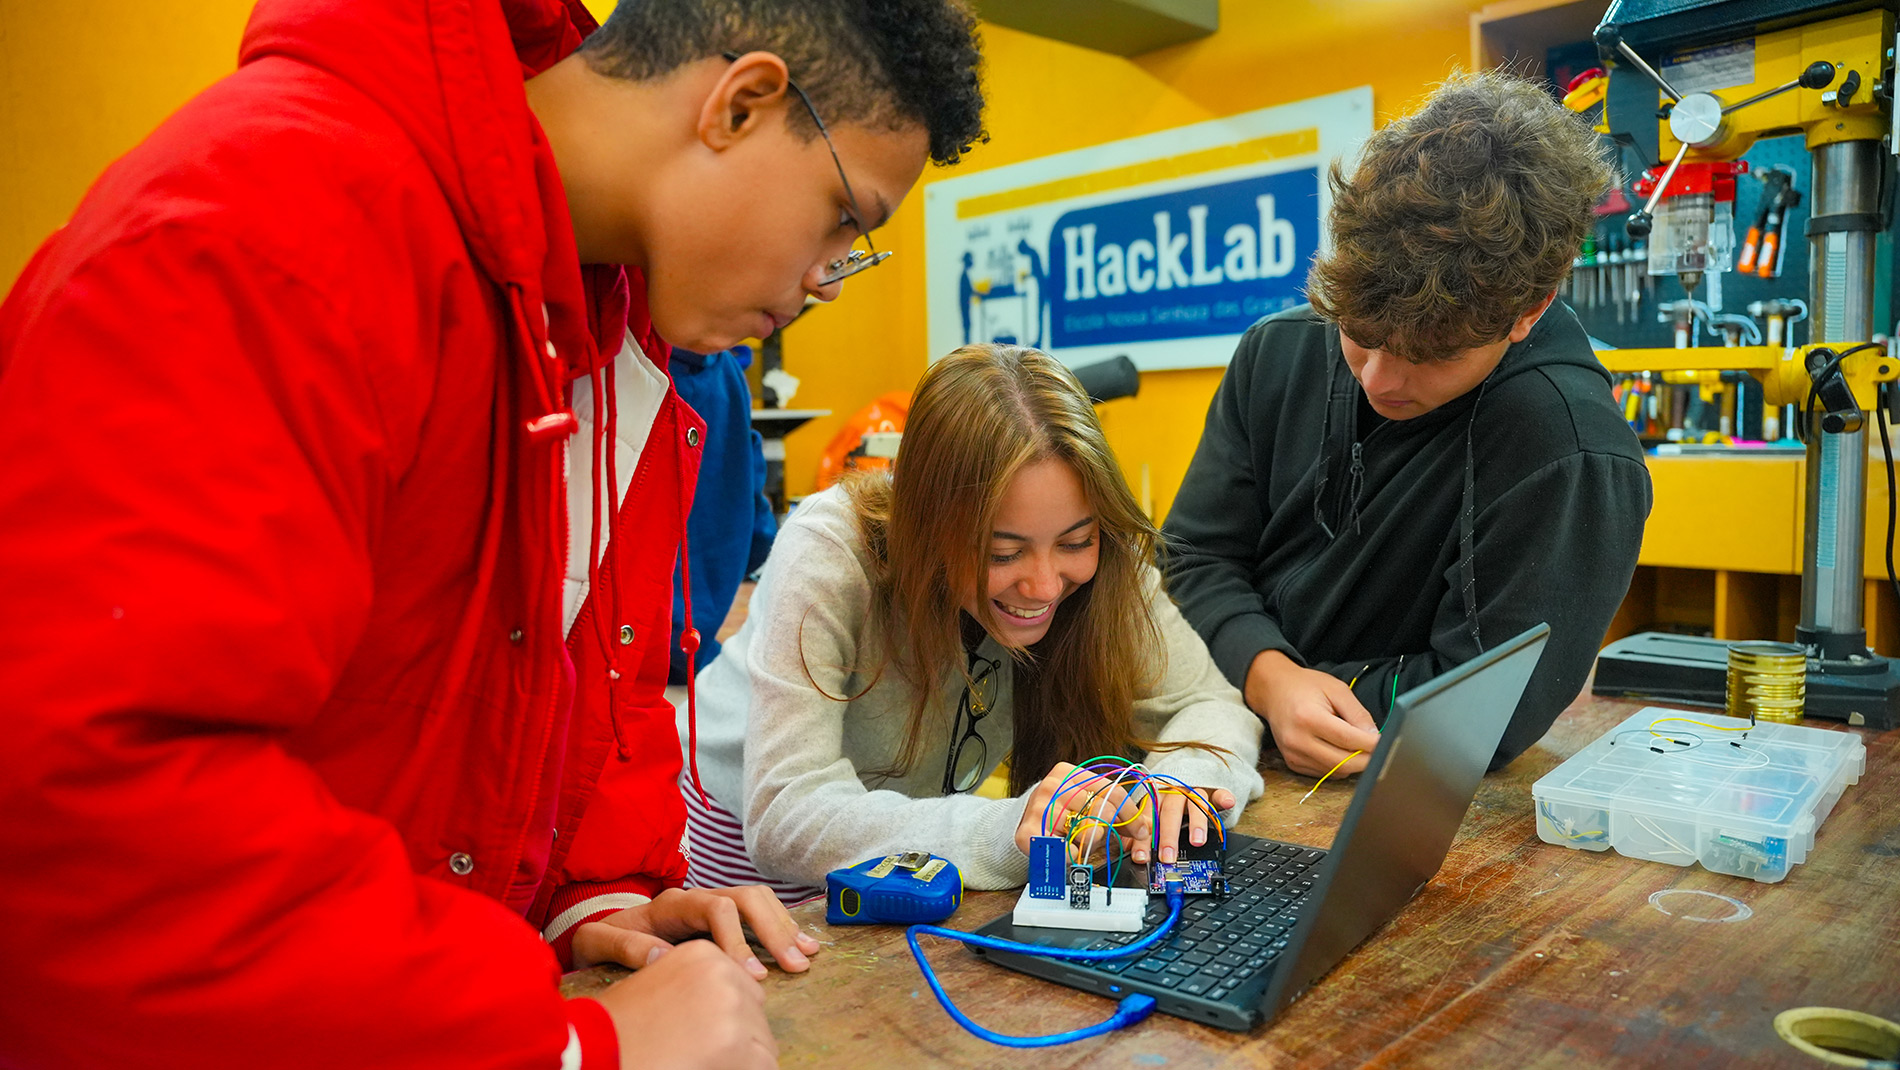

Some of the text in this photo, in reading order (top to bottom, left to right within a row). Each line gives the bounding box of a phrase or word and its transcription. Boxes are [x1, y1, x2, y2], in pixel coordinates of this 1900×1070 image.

[1062, 193, 1296, 301] HackLab
[1151, 303, 1211, 324] Senhora
[1213, 301, 1241, 318] das
